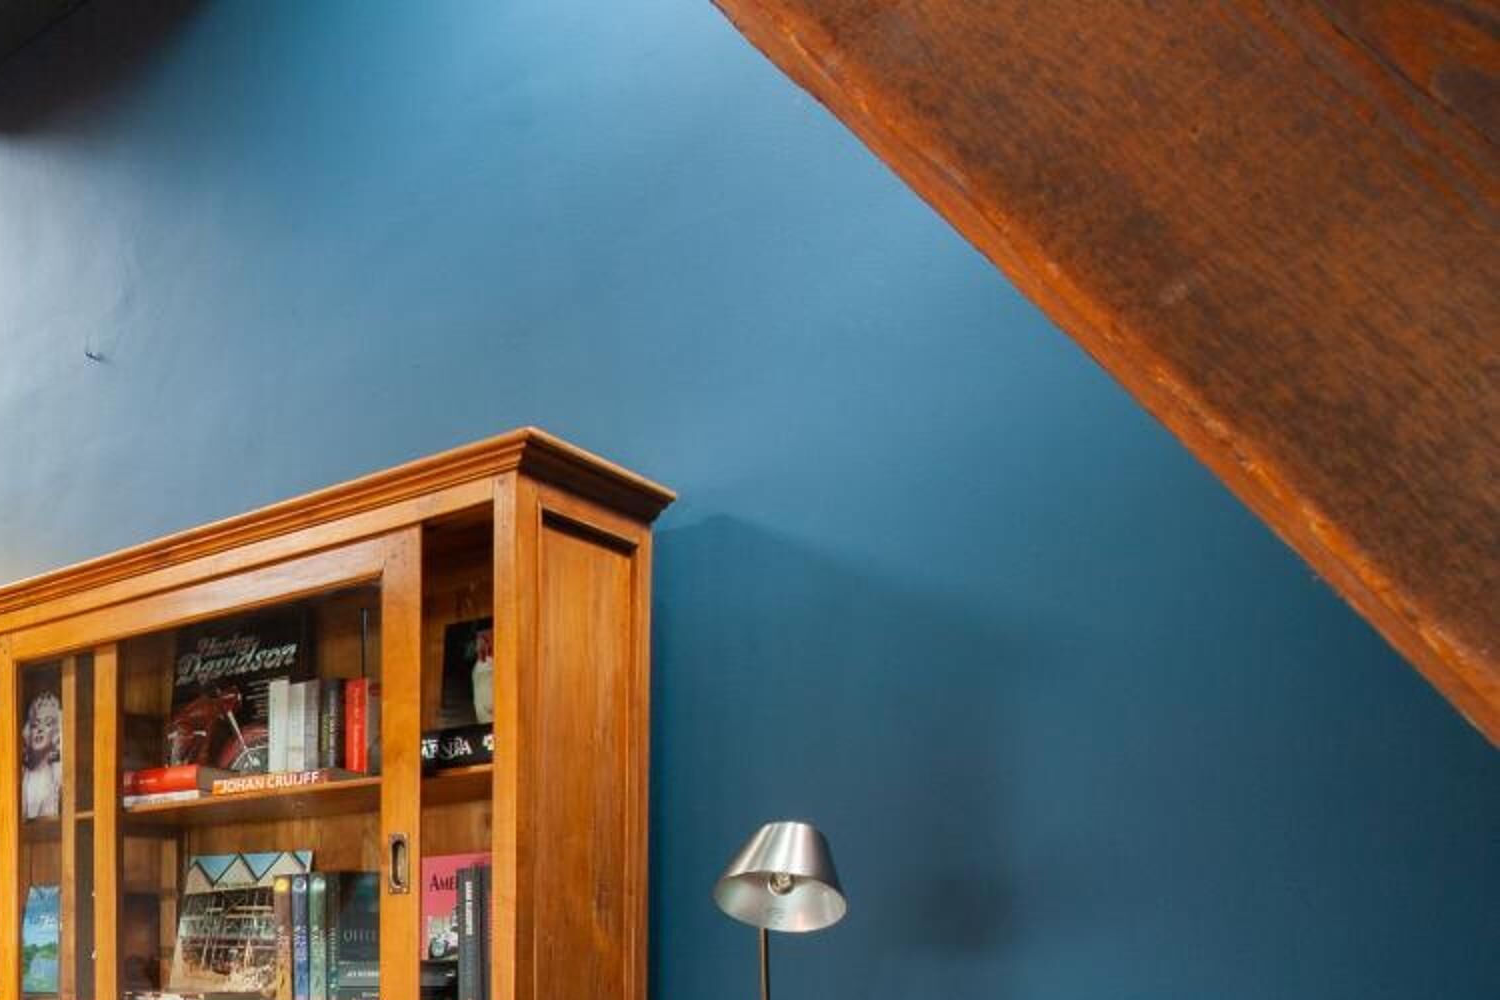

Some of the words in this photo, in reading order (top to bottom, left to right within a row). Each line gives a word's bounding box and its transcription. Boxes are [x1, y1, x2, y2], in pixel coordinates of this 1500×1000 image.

[176, 643, 298, 686] Davidson
[214, 776, 265, 795] JOHAN
[429, 872, 458, 893] AME
